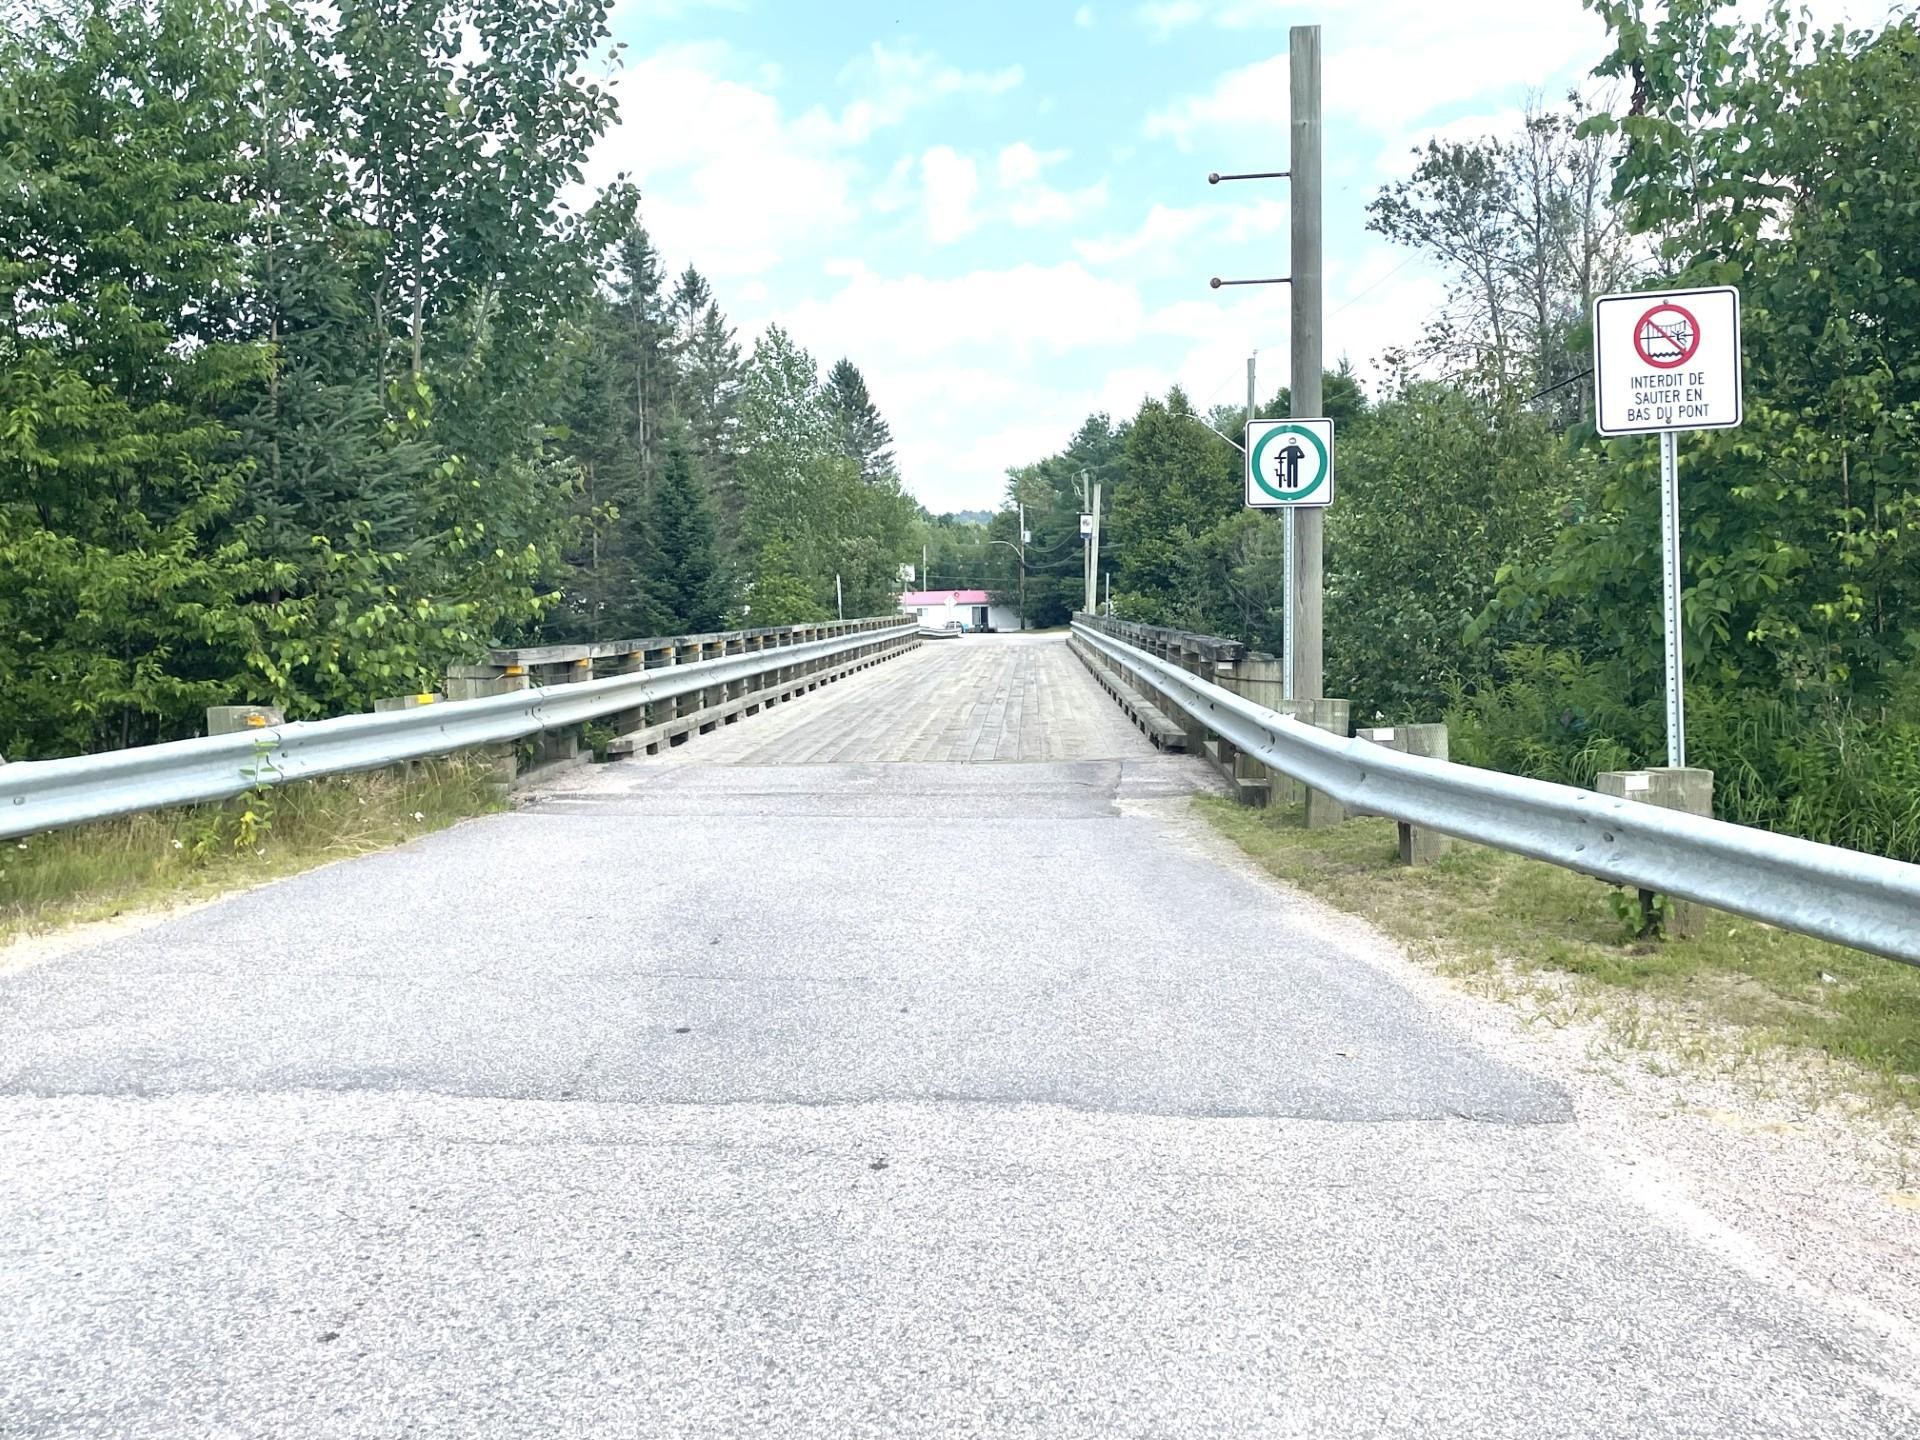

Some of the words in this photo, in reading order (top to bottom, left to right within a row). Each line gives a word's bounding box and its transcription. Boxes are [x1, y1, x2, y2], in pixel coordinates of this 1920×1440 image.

[1631, 373, 1684, 389] INTERDIT
[1689, 371, 1705, 386] DE
[1635, 389, 1680, 405] SAUTER
[1686, 388, 1702, 401] EN
[1628, 408, 1650, 422] BAS
[1657, 406, 1672, 420] DU
[1678, 404, 1709, 419] PONT
